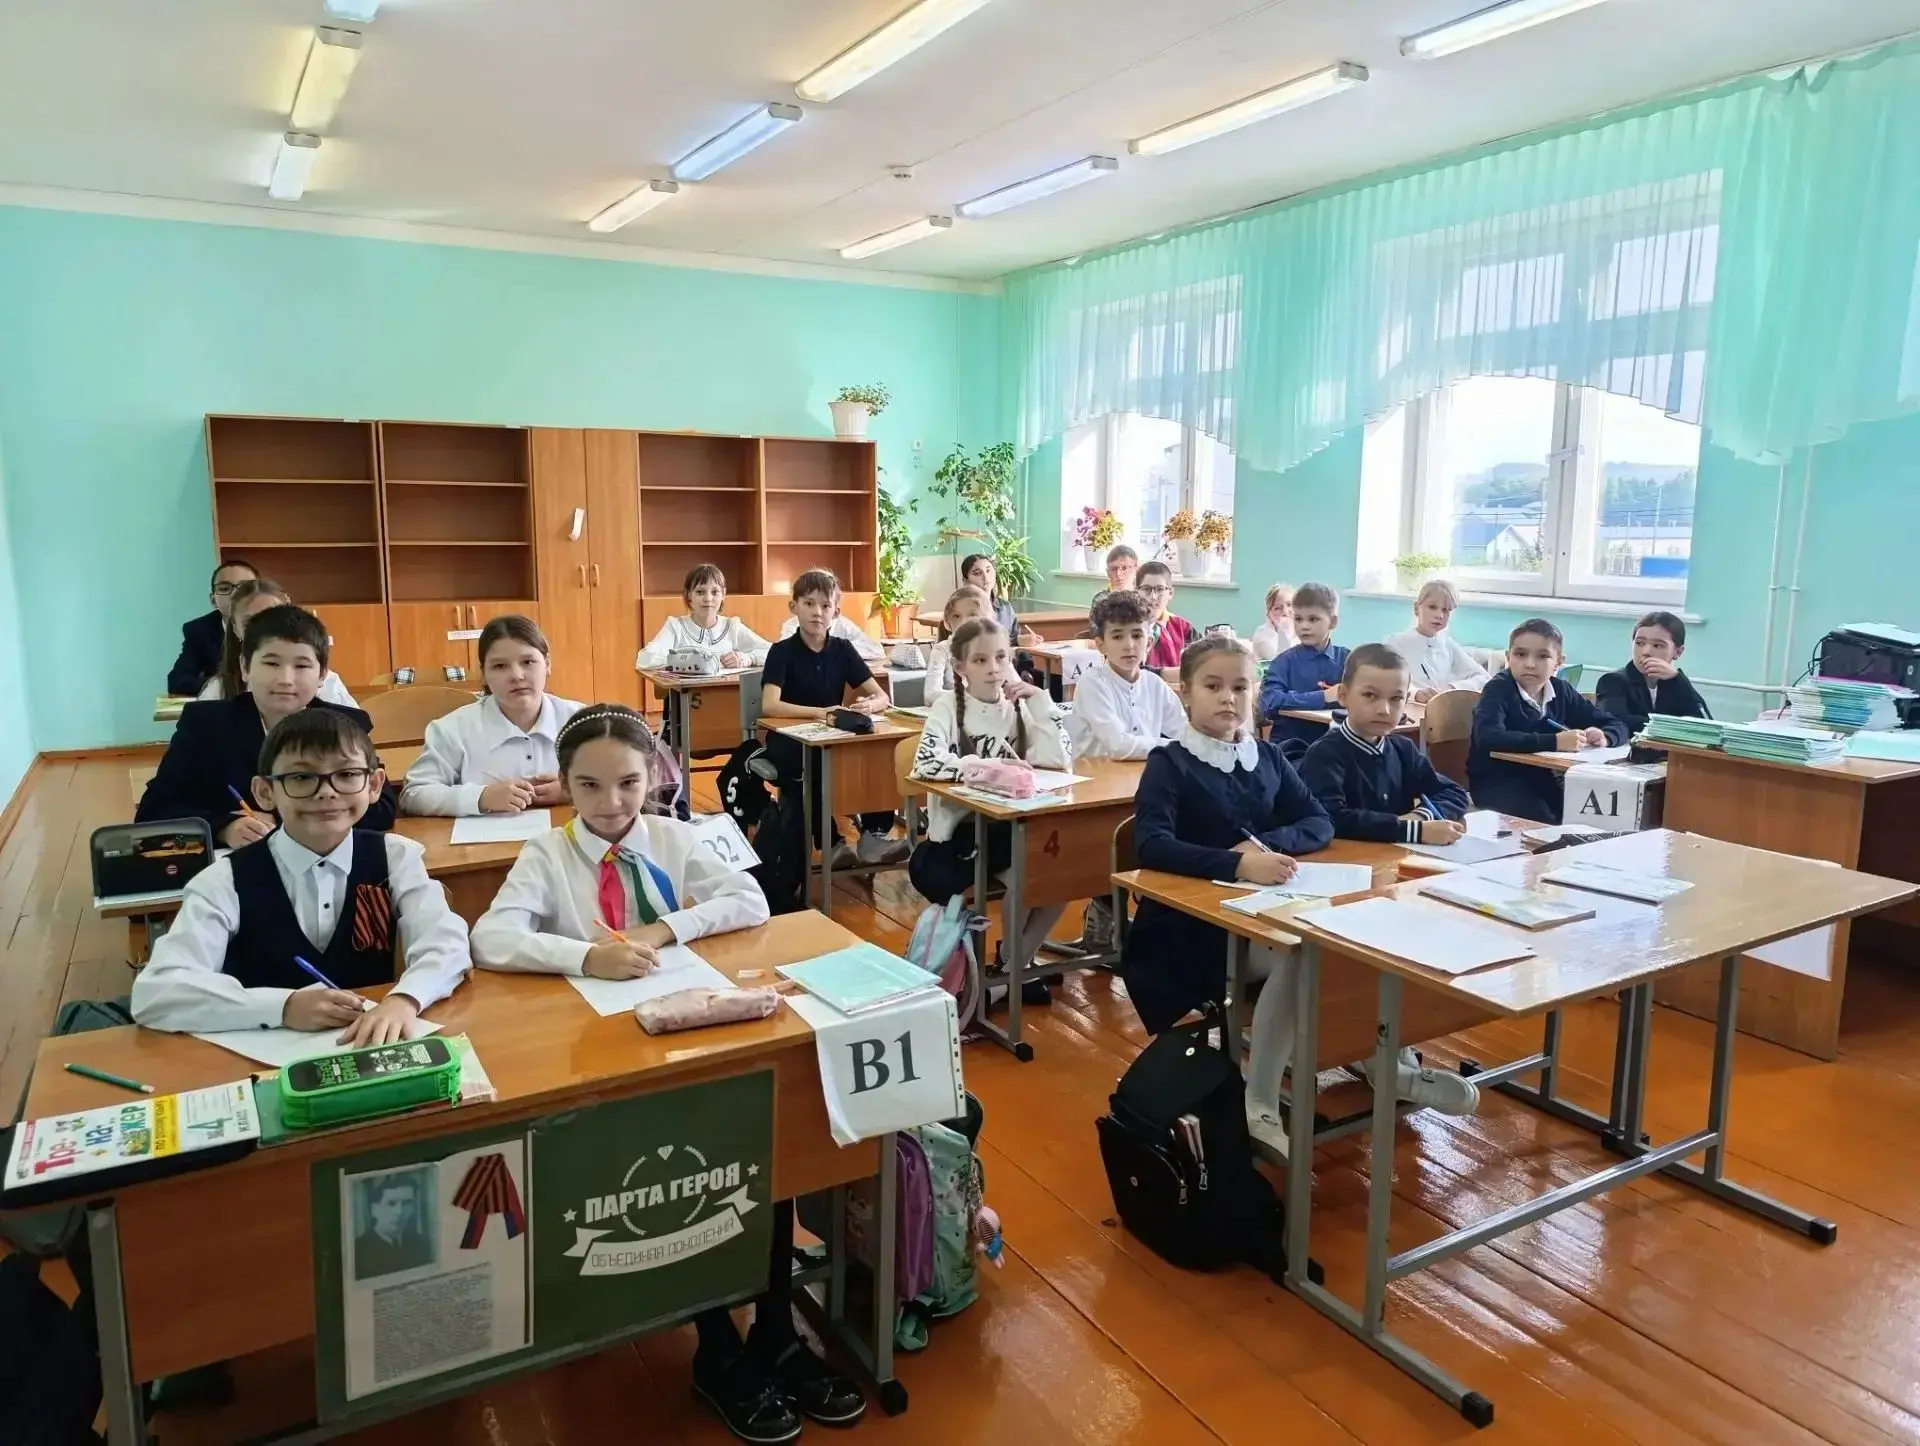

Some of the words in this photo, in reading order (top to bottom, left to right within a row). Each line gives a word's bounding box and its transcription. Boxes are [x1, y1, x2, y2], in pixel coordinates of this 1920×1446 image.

[1044, 830, 1060, 858] 4
[586, 1184, 665, 1223] ПАРТА
[670, 1161, 740, 1200] ГЕРОЯ
